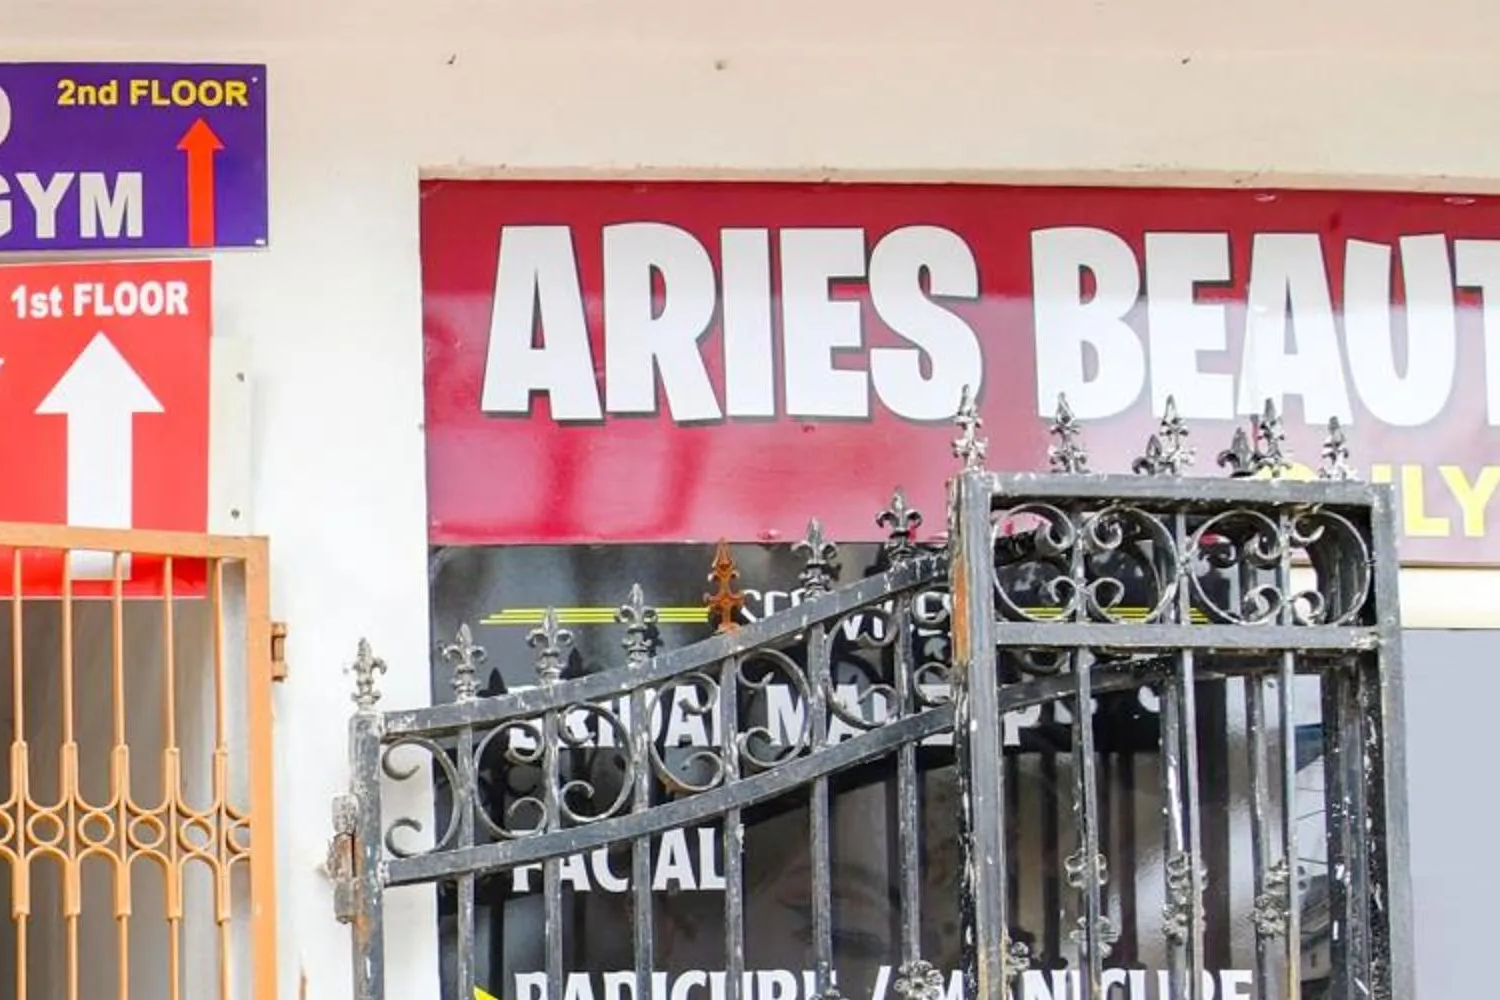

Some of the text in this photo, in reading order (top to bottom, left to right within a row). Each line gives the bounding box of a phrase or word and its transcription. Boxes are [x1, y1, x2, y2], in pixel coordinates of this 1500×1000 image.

[57, 77, 248, 107] 2nd FLOOR
[10, 282, 189, 319] 1st FLOOR
[481, 221, 983, 421] ARIES
[511, 828, 731, 893] FACAL
